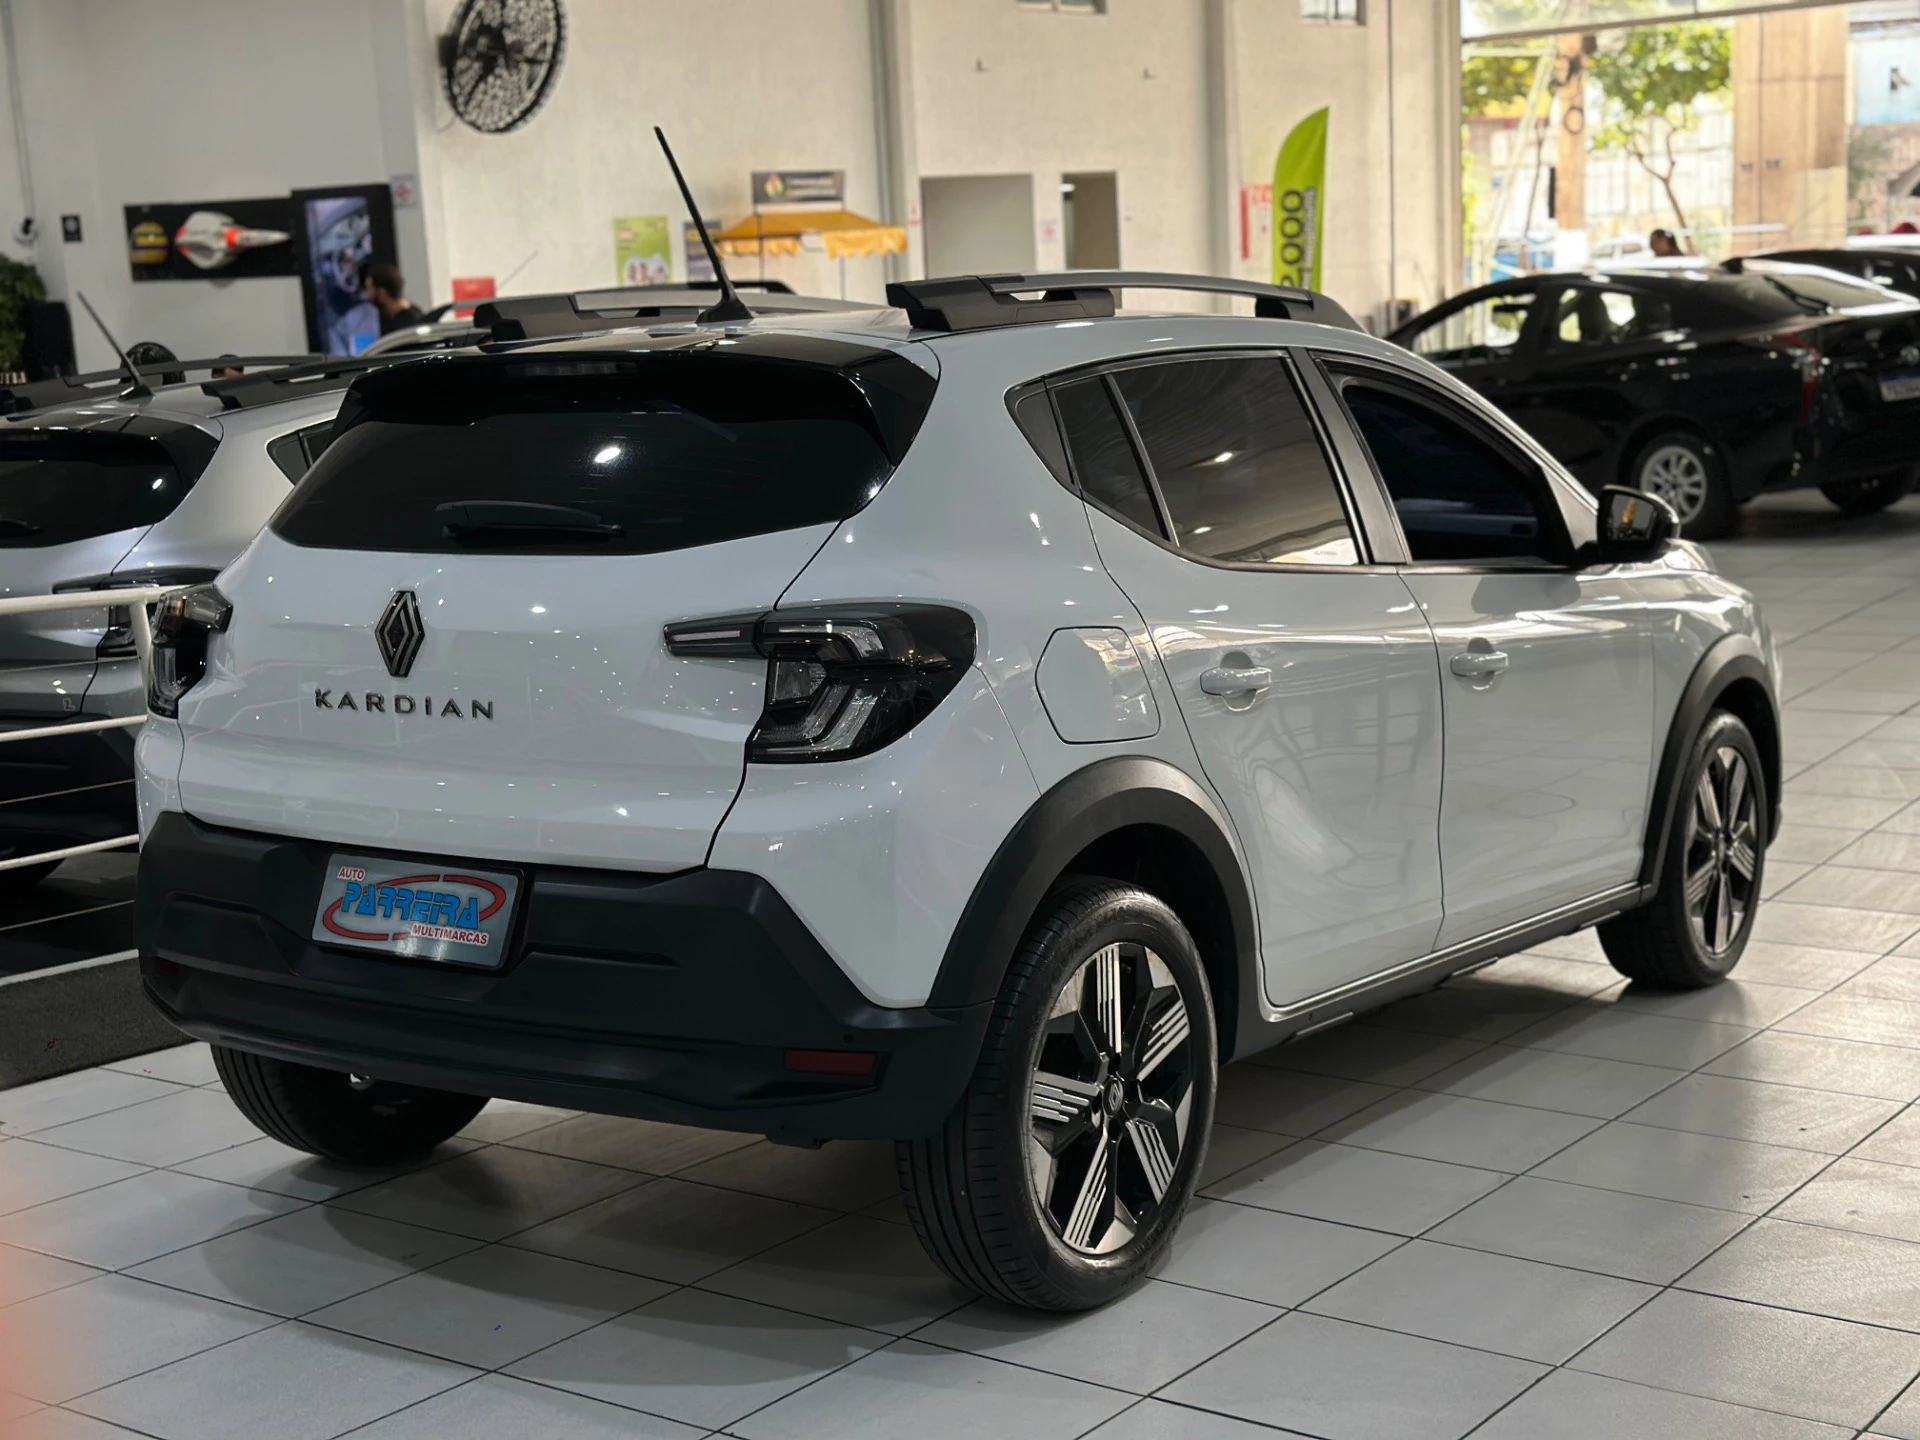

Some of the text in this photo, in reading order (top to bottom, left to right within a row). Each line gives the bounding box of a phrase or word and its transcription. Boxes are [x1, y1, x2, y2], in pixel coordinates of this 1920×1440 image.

[315, 688, 494, 720] KARDIAN
[338, 867, 365, 880] AUTO
[340, 881, 479, 930] PARREIRA
[412, 924, 489, 945] MULTIMARCAS
